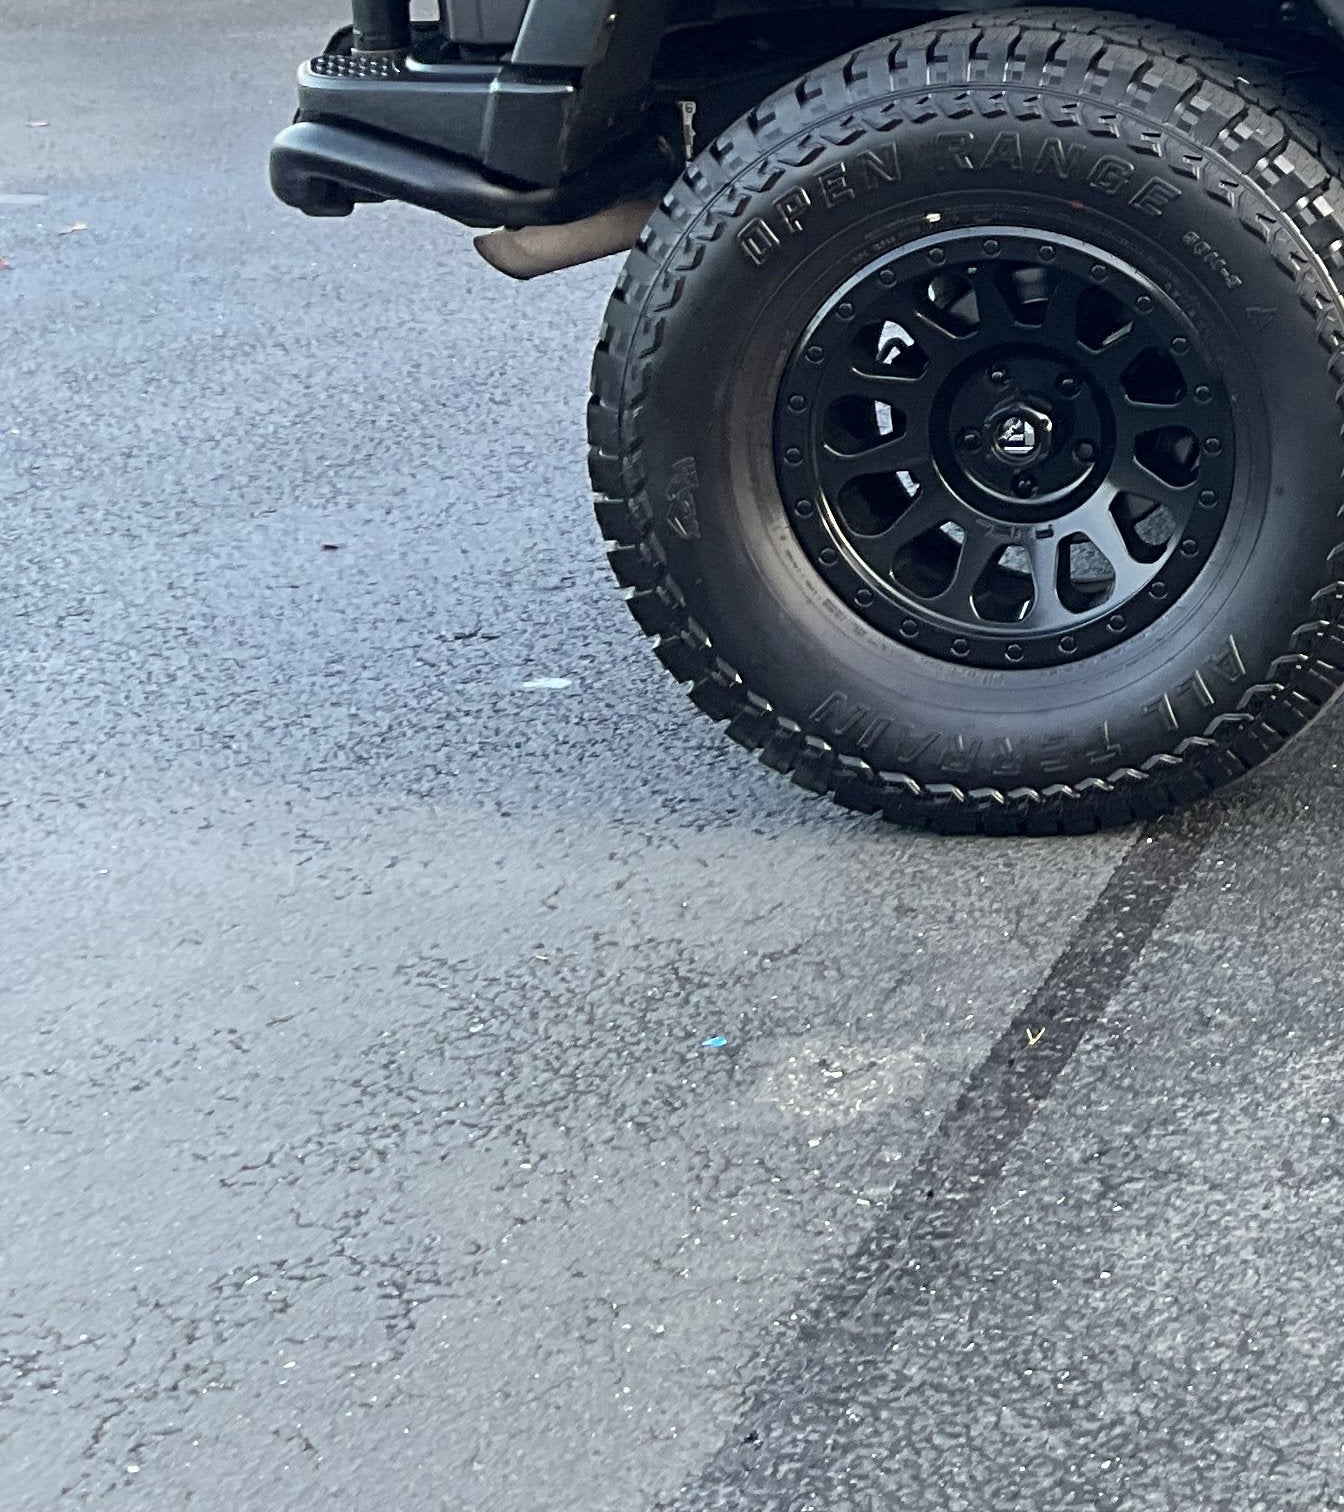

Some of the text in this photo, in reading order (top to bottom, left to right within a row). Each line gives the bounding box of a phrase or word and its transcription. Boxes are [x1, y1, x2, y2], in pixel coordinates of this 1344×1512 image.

[736, 131, 1183, 267] OPEN RANGE
[1142, 634, 1246, 730] ALL
